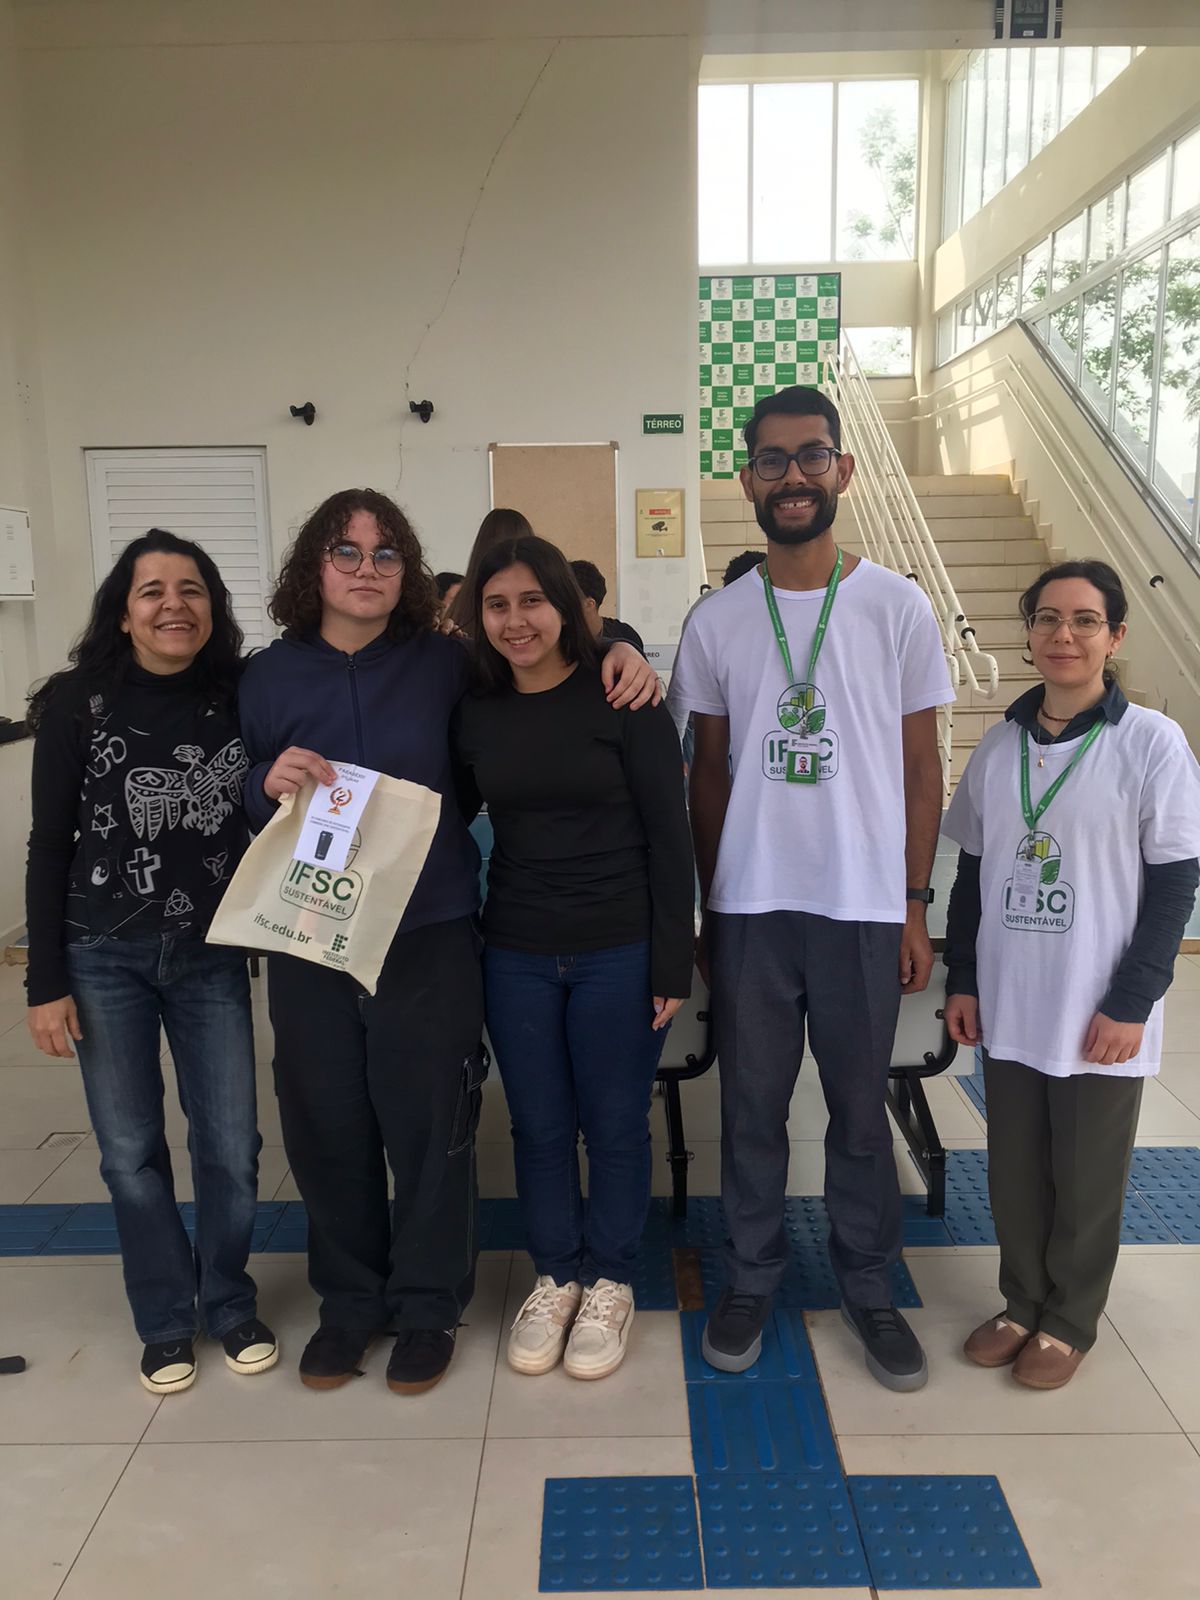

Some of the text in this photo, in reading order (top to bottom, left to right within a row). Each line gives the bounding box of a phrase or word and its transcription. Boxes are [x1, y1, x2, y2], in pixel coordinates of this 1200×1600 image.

[646, 418, 682, 429] TÉRREO
[769, 737, 833, 763] IFC
[289, 860, 355, 902] IFSC
[283, 885, 348, 916] SUSTENTÁVEL
[1006, 886, 1067, 914] ISC
[253, 912, 313, 944] ifsc.edu.br
[1005, 914, 1067, 927] SUSTENTÁVEL
